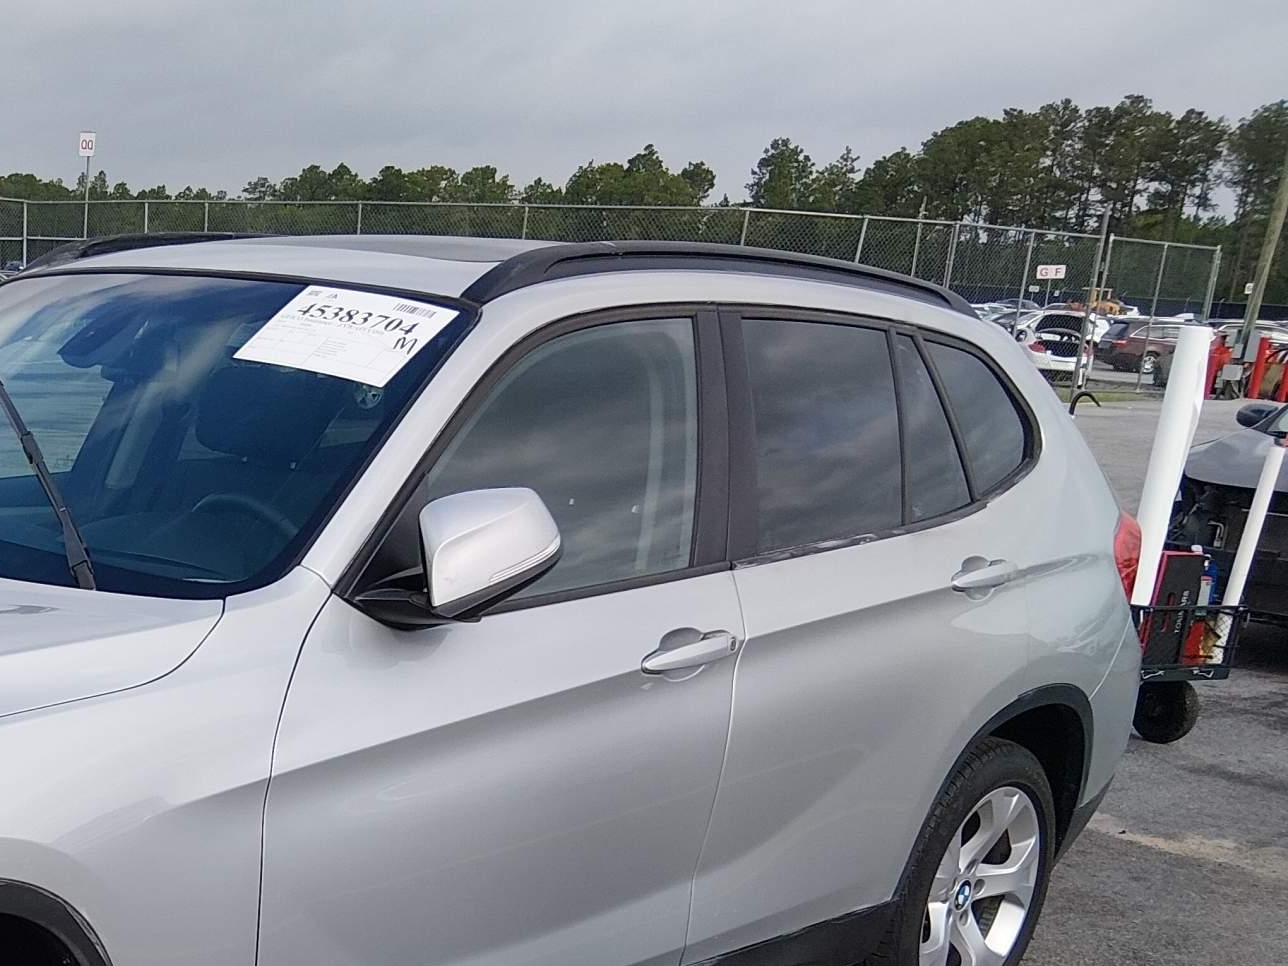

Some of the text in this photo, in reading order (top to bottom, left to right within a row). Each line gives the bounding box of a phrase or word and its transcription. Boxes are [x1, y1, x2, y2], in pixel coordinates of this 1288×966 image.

[1040, 267, 1062, 277] G F
[297, 303, 420, 335] 45383704
[392, 336, 418, 355] M
